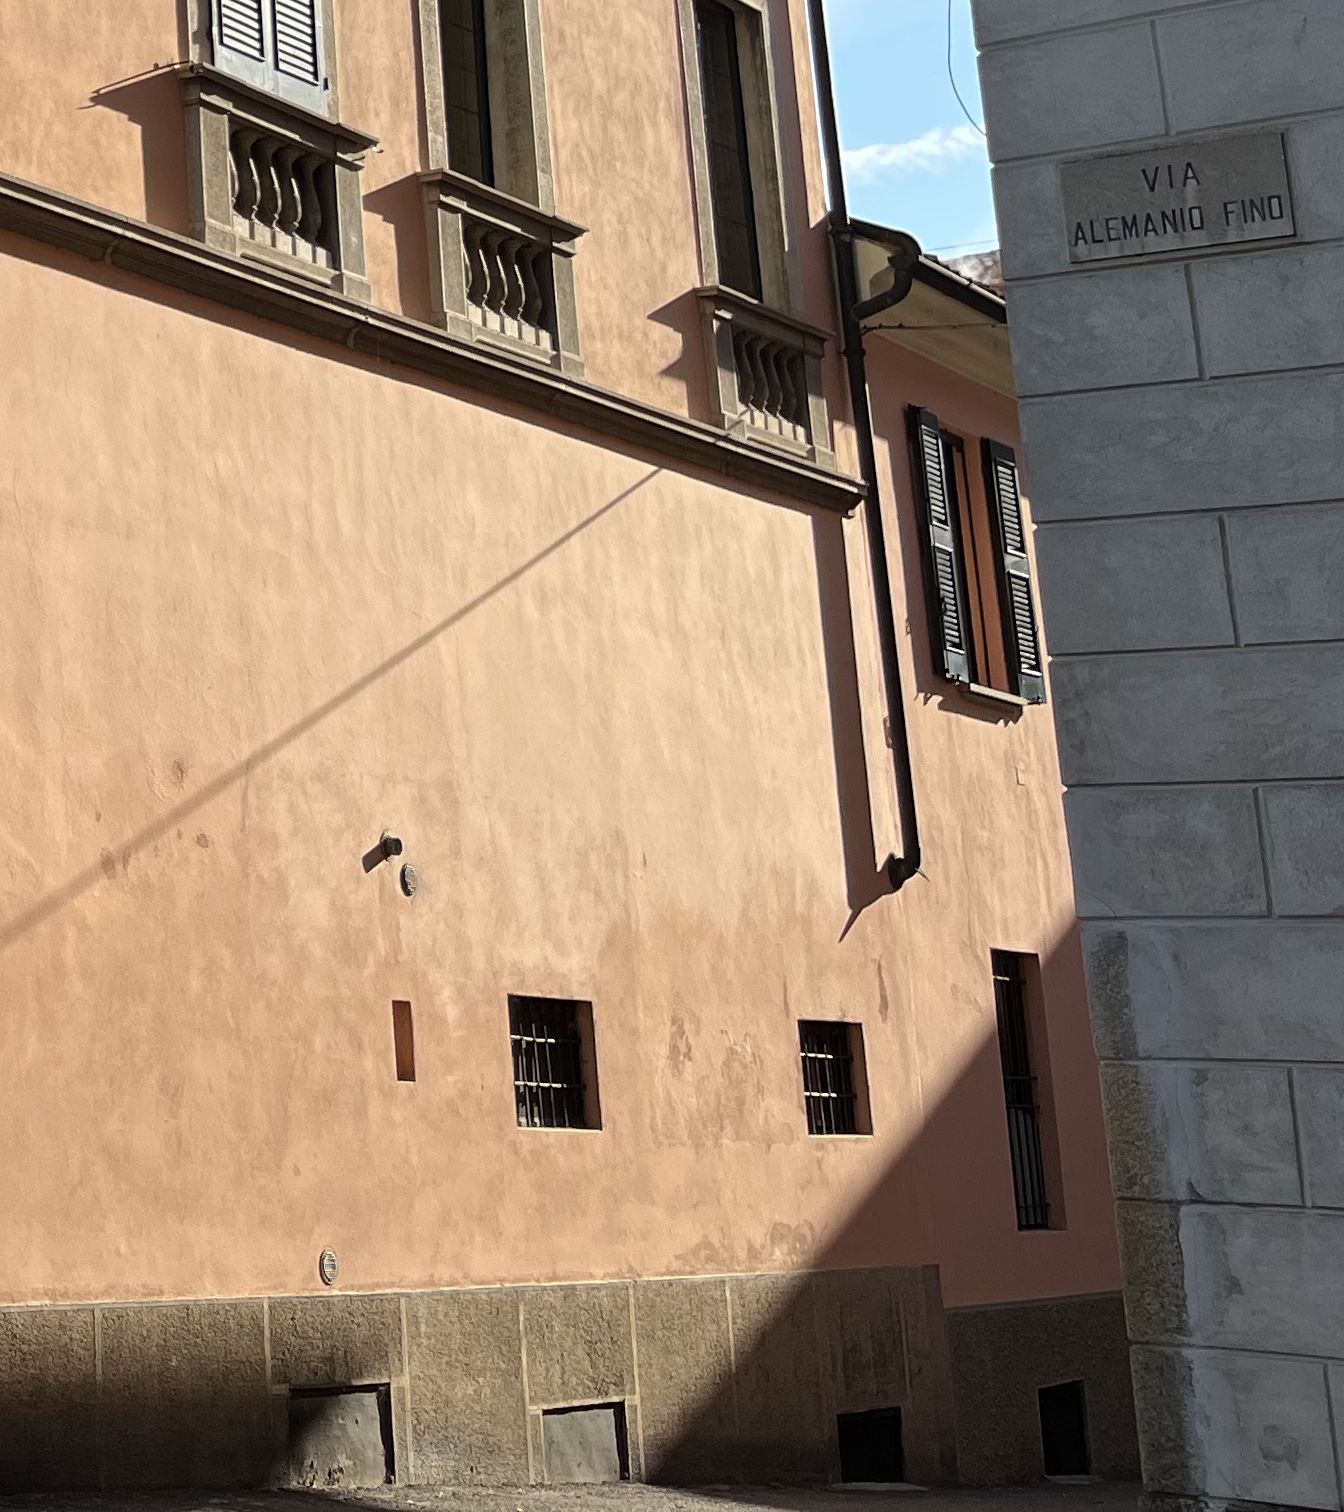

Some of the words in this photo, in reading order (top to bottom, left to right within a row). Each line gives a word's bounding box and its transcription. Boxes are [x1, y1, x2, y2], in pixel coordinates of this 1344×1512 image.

[1141, 161, 1201, 192] VIA
[1073, 205, 1205, 247] ALEMANIO
[1223, 195, 1284, 226] FINO
